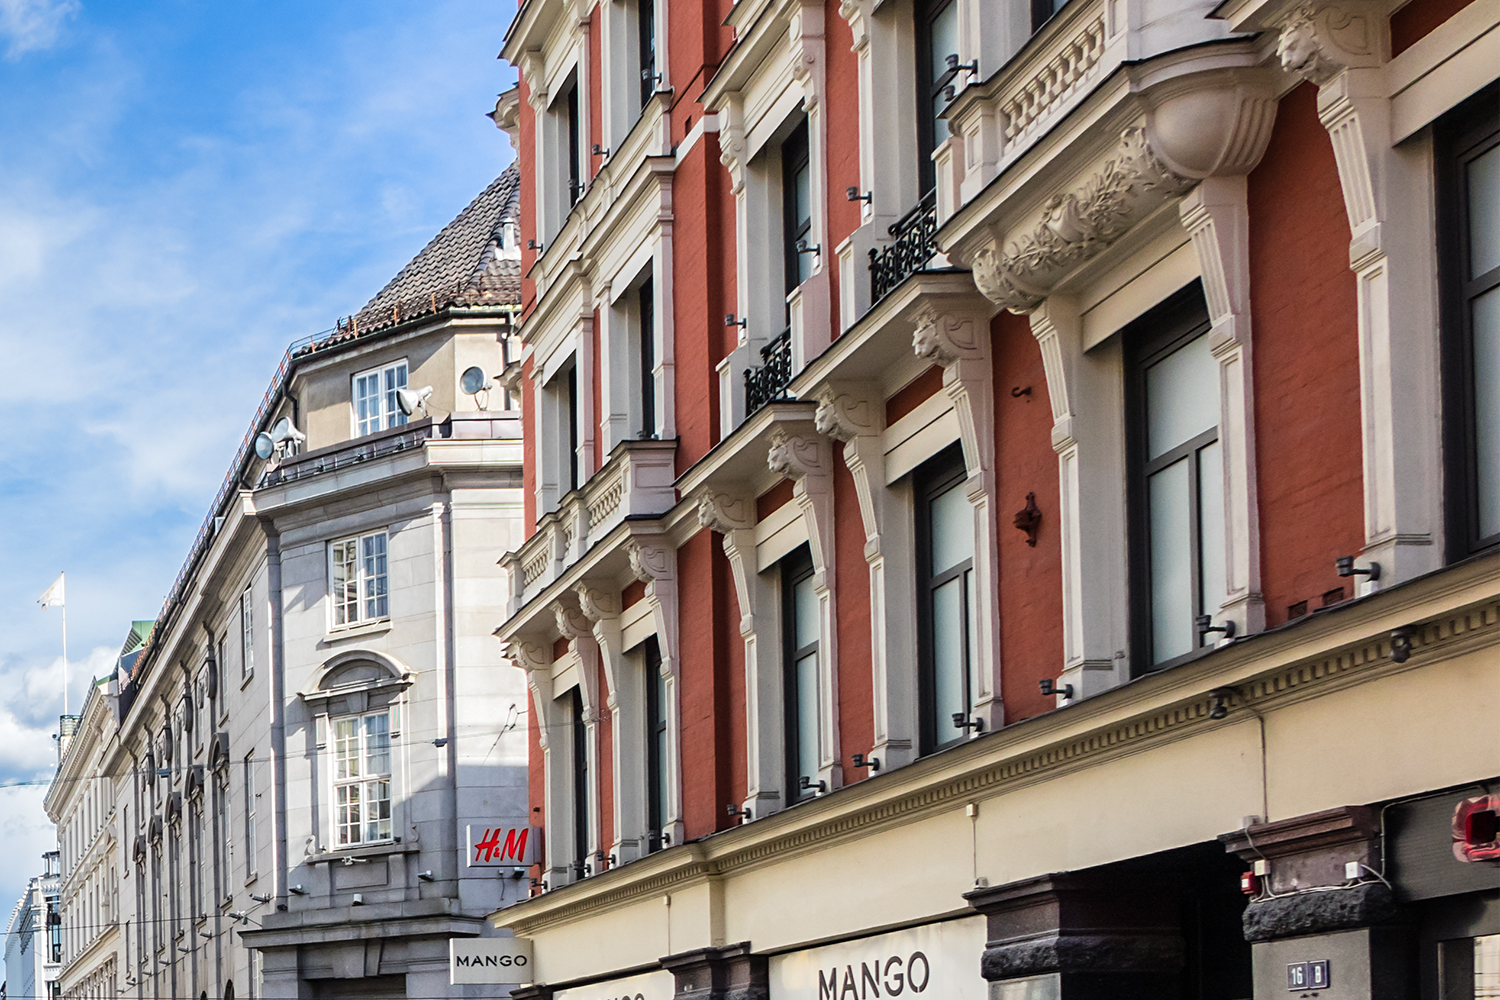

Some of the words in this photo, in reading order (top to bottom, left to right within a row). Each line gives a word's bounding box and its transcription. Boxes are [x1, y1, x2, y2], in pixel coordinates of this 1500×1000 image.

[474, 827, 529, 863] H&M
[456, 955, 528, 967] MANGO
[1291, 966, 1303, 985] 16
